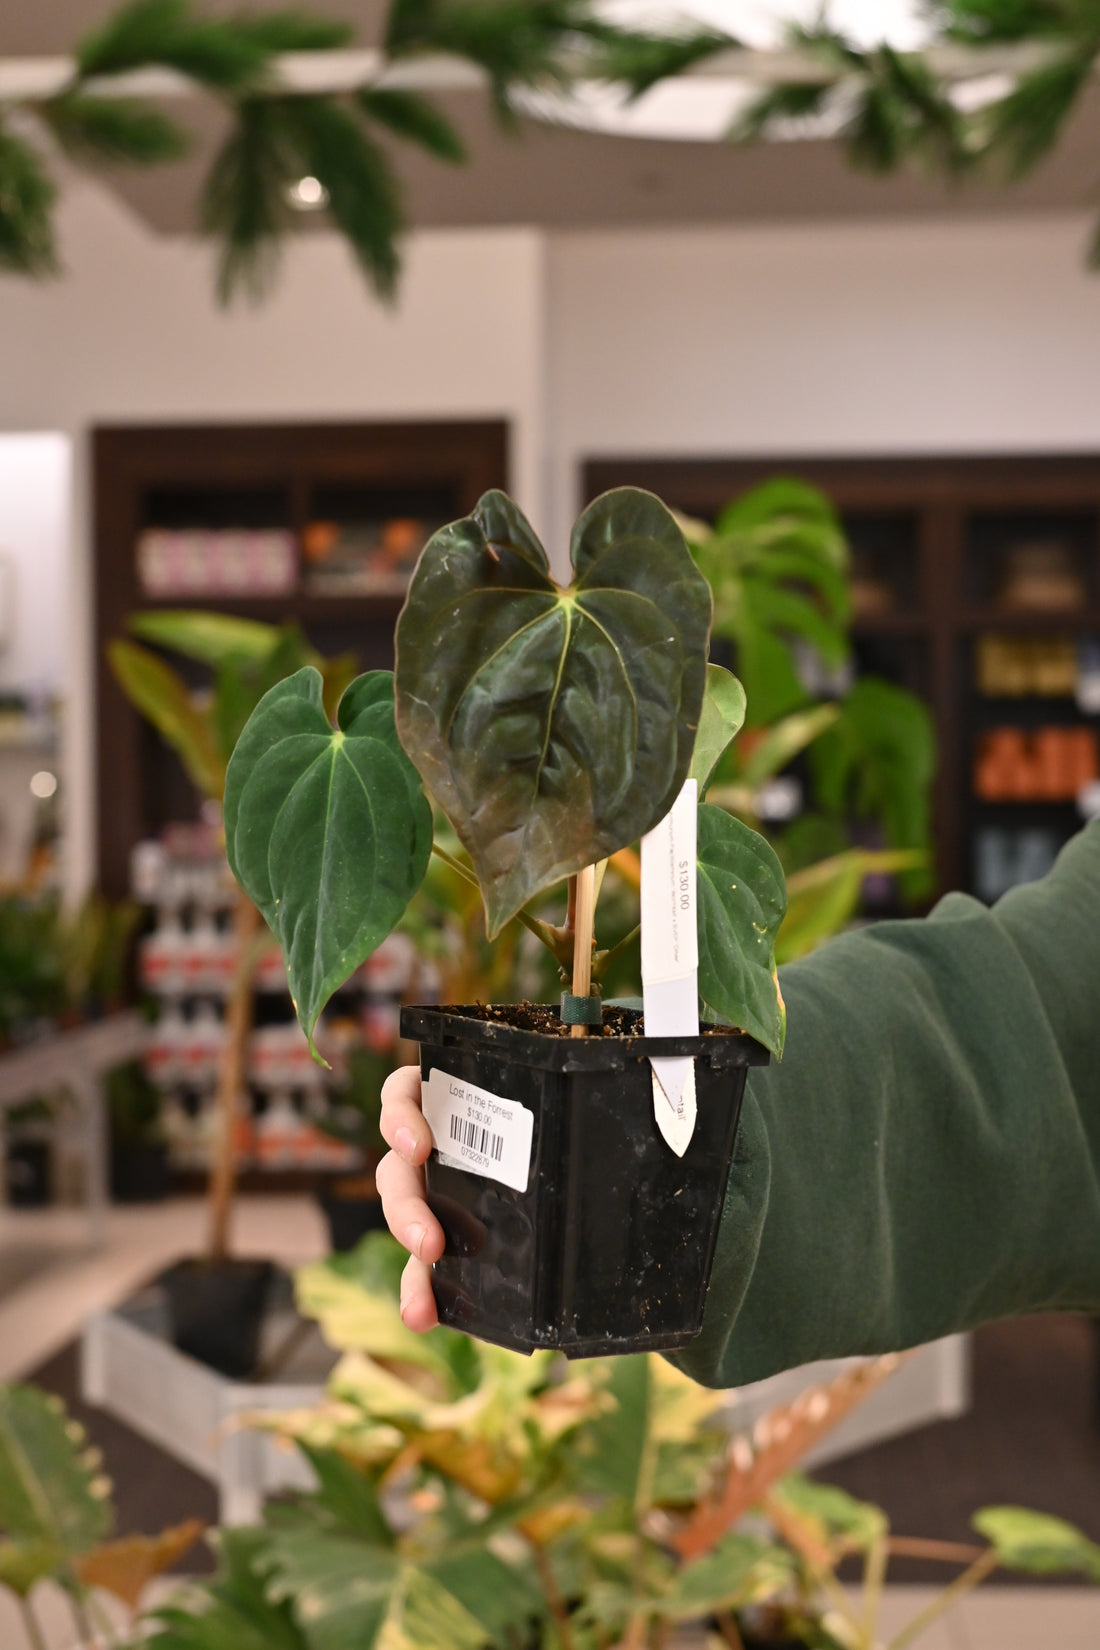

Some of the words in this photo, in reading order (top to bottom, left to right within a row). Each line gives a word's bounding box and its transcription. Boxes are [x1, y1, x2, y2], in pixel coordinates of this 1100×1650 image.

[449, 1083, 464, 1098] Lost
[466, 1092, 473, 1103] in
[475, 1095, 486, 1109] the
[488, 1100, 513, 1121] Forrest
[467, 1107, 493, 1126] $130.00
